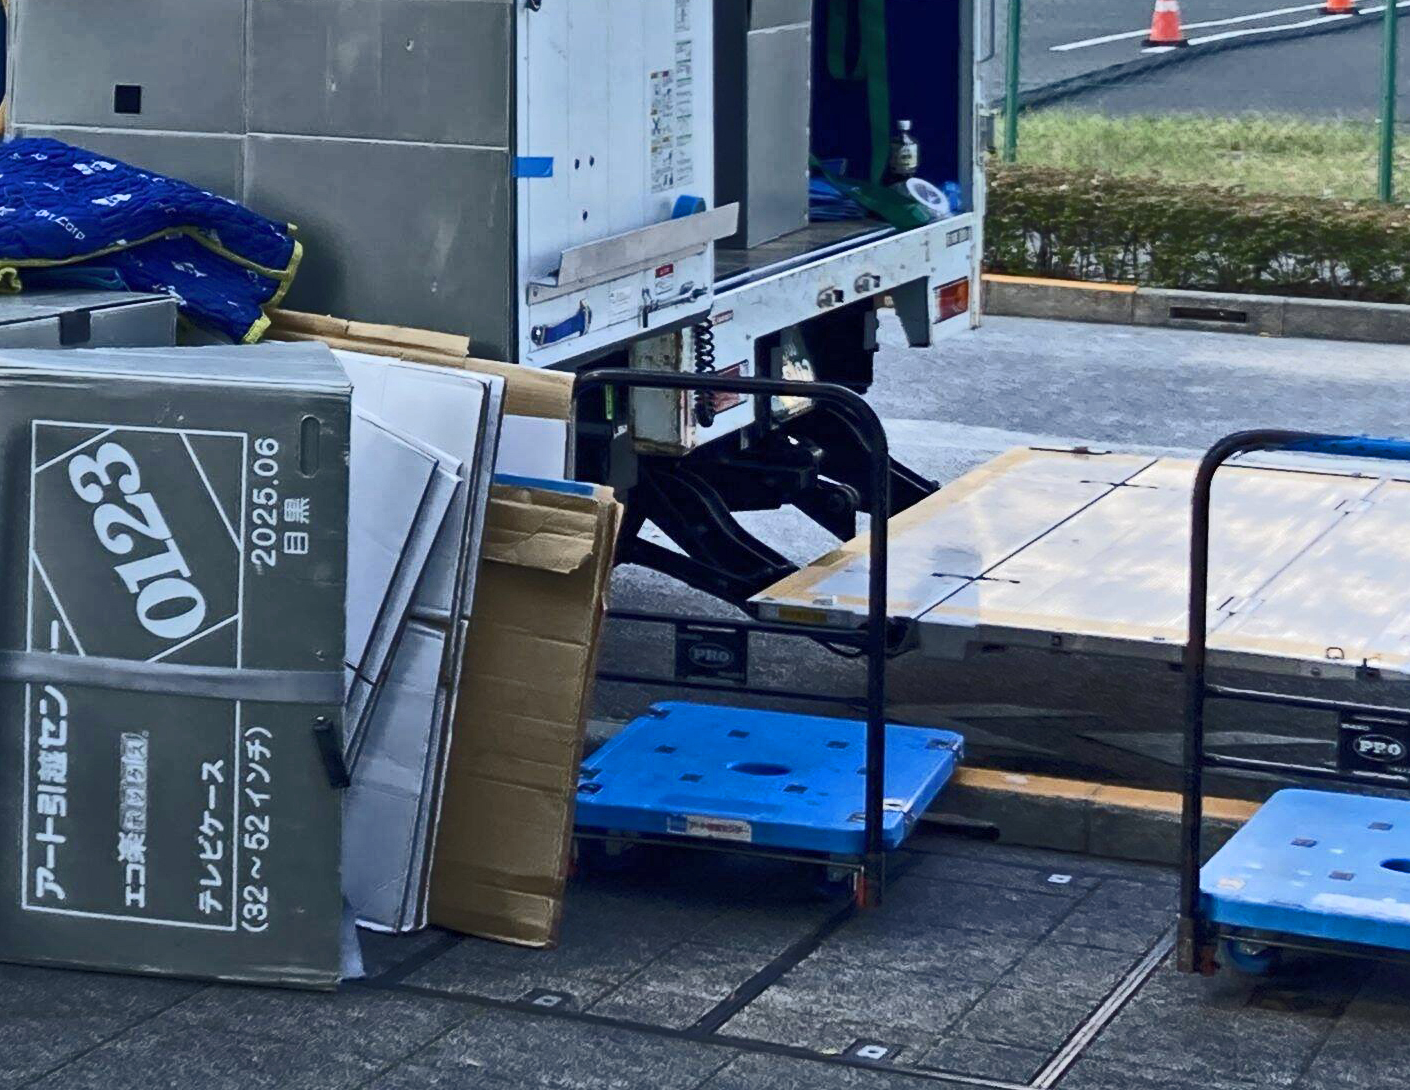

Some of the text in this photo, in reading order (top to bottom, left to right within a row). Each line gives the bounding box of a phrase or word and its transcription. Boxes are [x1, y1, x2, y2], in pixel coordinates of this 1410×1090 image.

[68, 440, 207, 640] 0123
[250, 438, 279, 567] 2025.06
[283, 497, 311, 555] 目黒
[35, 619, 68, 900] アート引越センー
[1358, 740, 1402, 756] PRO
[198, 759, 225, 914] テレビケース
